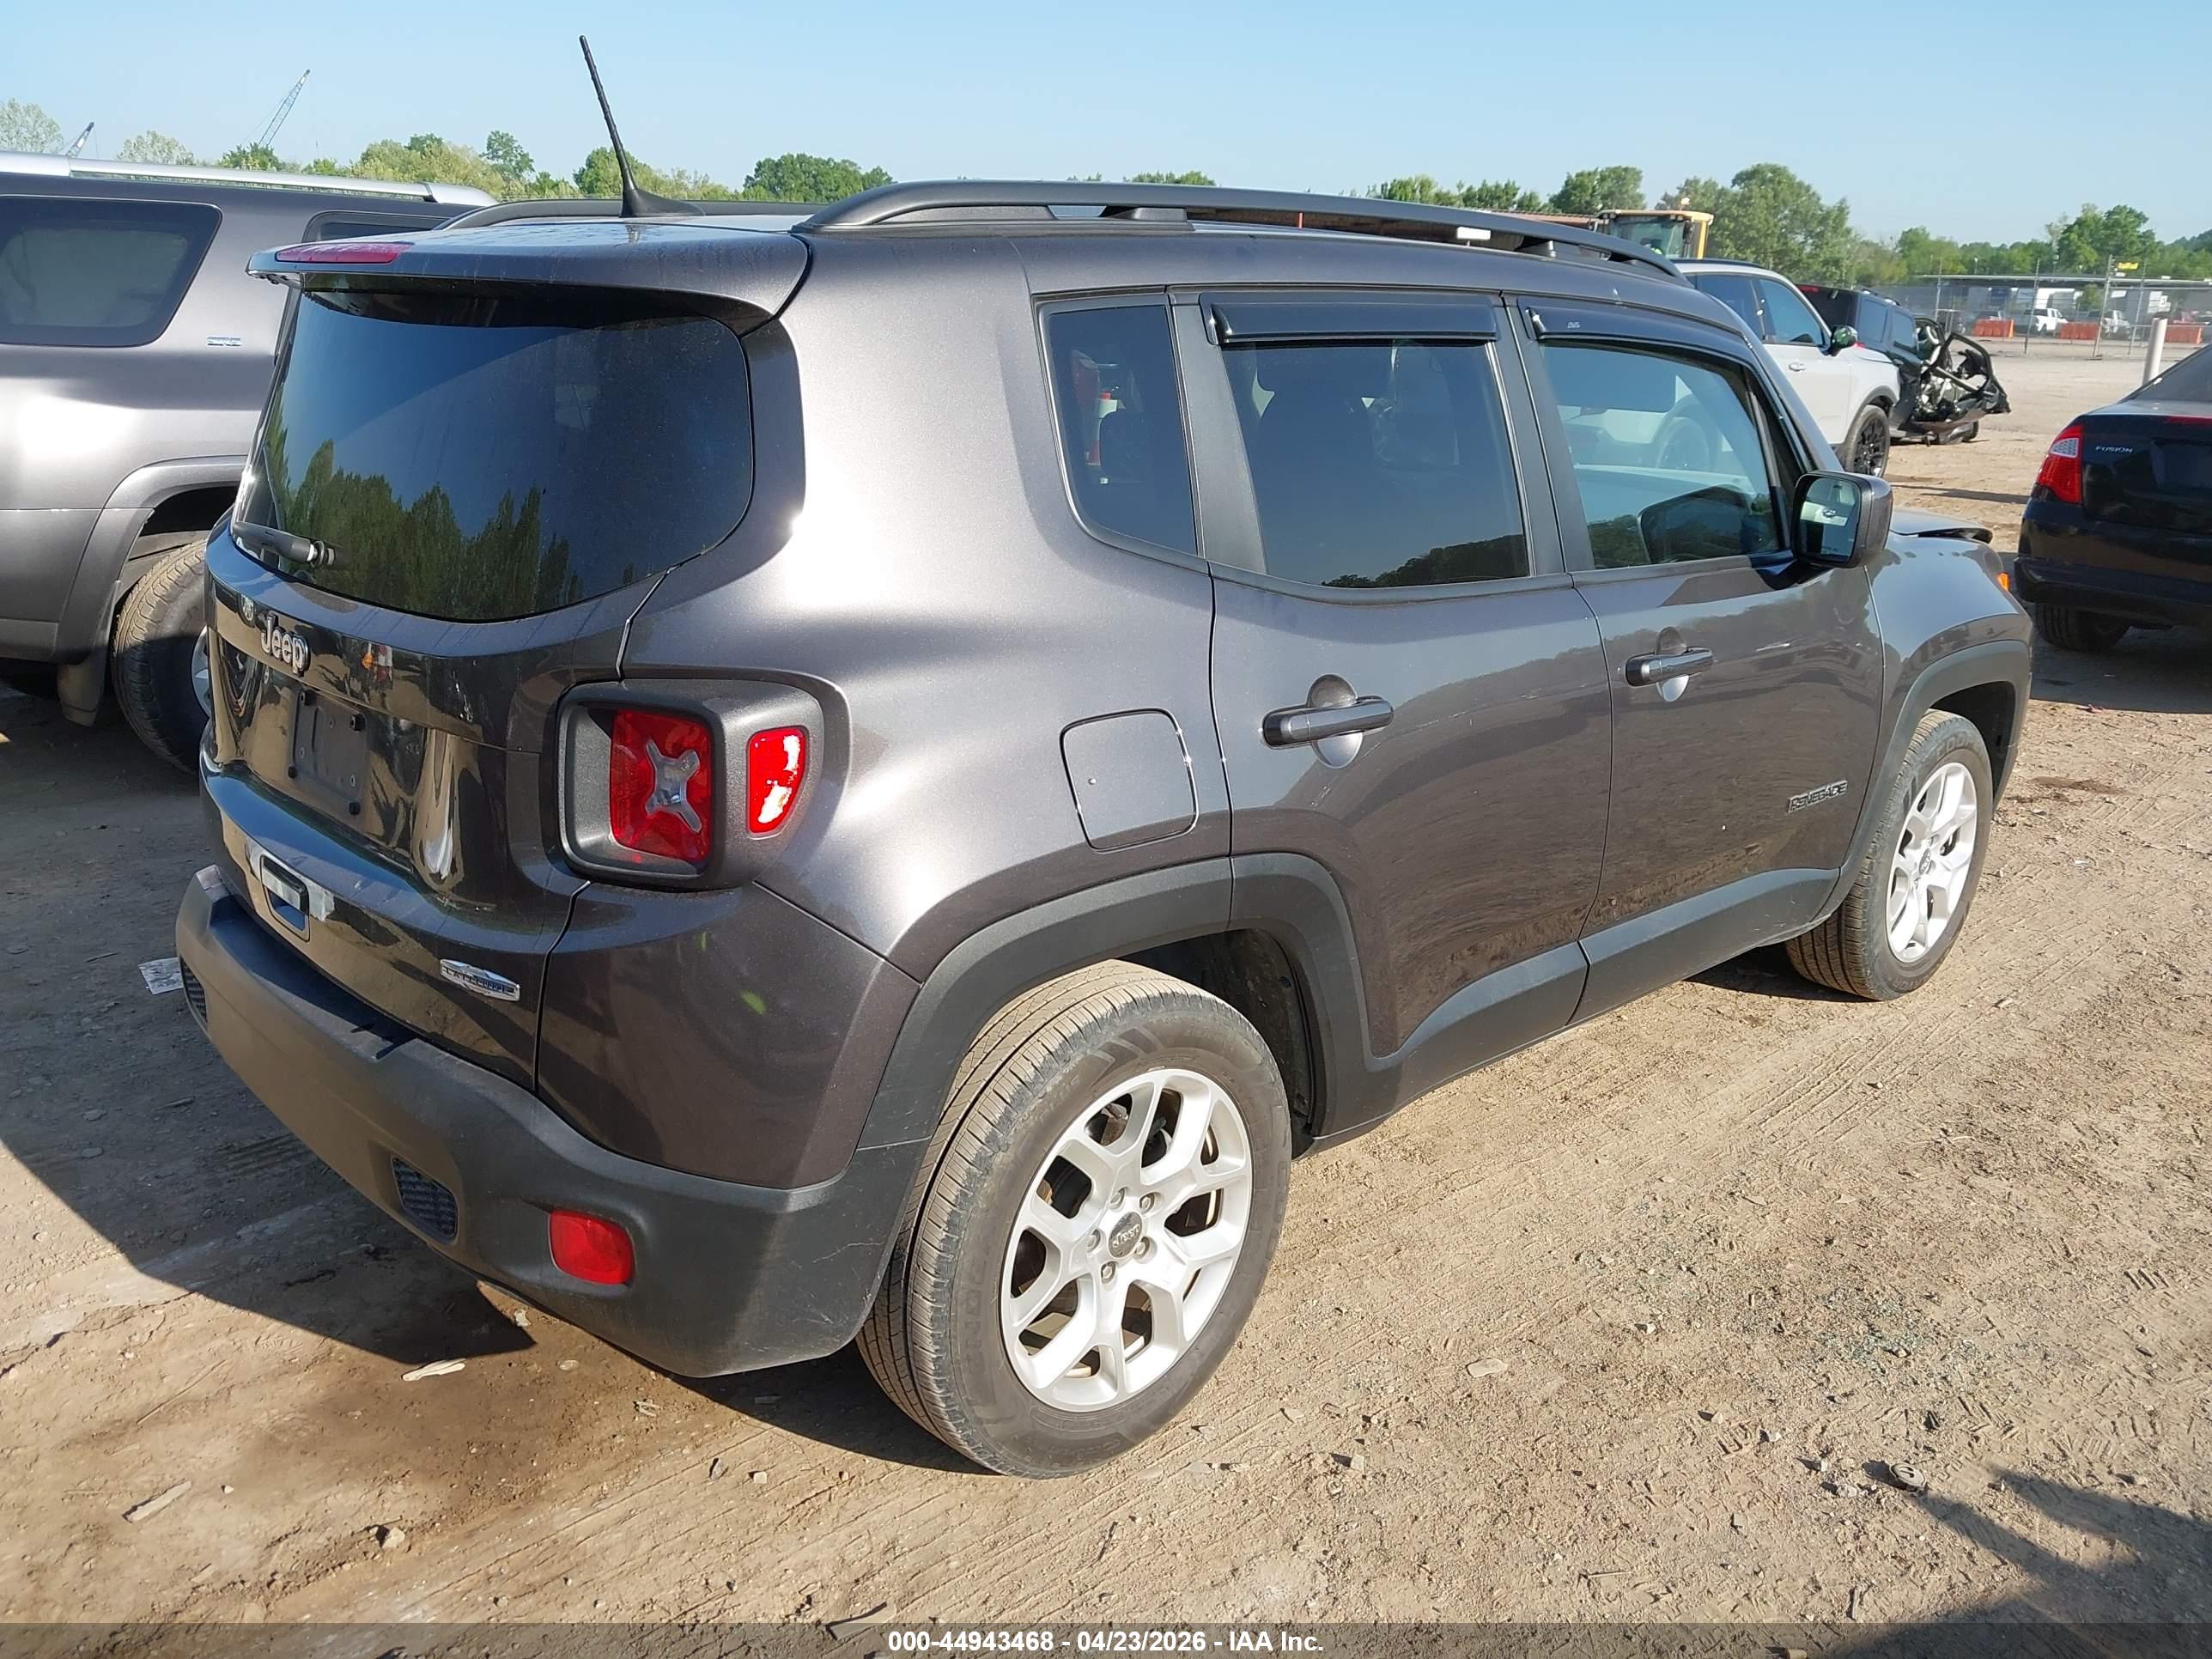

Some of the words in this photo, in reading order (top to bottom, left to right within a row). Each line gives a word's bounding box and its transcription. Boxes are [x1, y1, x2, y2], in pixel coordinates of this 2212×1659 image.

[260, 614, 310, 676] Jeep
[1788, 780, 1848, 813] RENEGADE
[1112, 1224, 1141, 1249] Jeep
